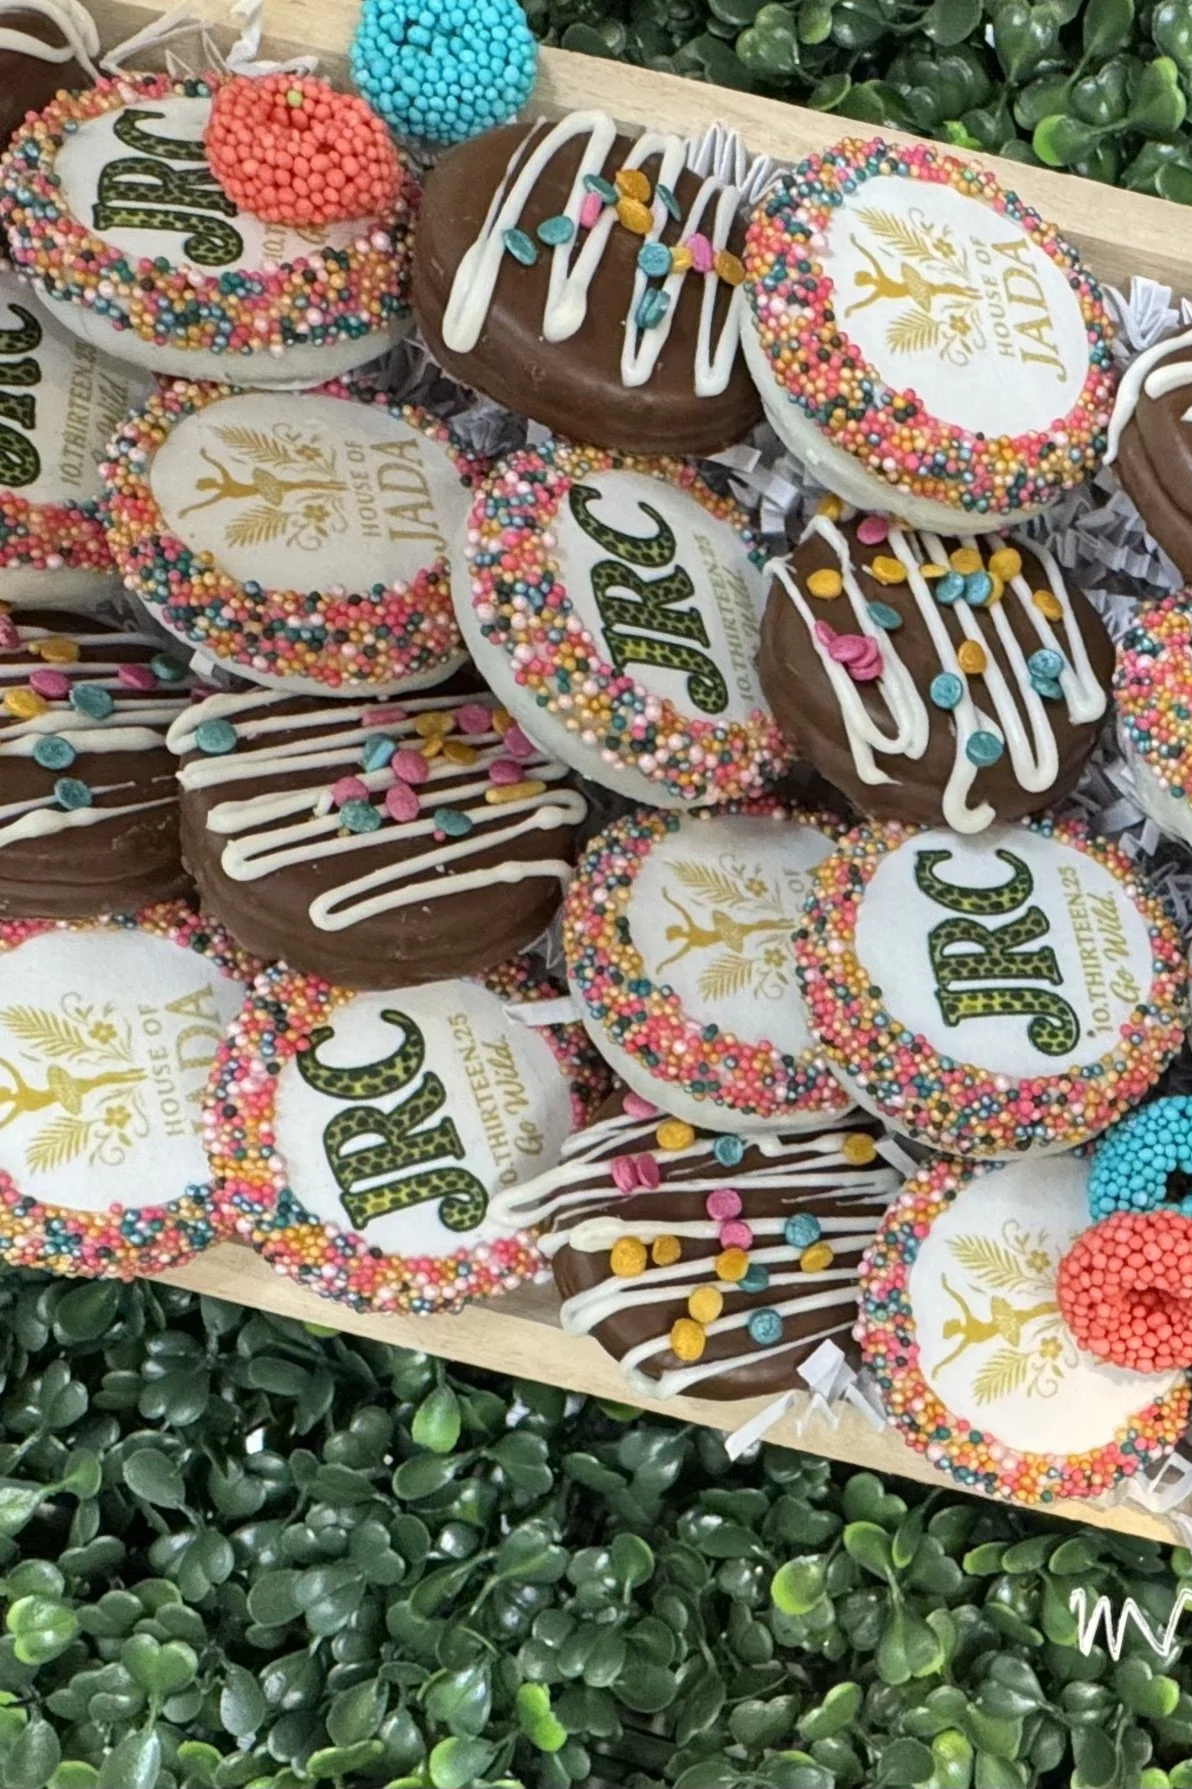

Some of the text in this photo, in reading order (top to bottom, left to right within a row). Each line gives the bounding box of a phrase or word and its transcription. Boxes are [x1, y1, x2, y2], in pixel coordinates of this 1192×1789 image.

[969, 234, 1015, 357] HOUSE OF
[991, 238, 1067, 383] JADA
[344, 440, 382, 537] HOUSE OF
[369, 438, 447, 552] JADA
[569, 484, 729, 714] JRC
[915, 849, 1081, 1056] JRC
[1057, 865, 1114, 1033] 10.THIRTEEN.25
[1086, 889, 1142, 1004] Go Wild.
[137, 1004, 185, 1137] HOUSE OF
[296, 1009, 490, 1231] JRC
[447, 1012, 519, 1188] 0.THIRTEEN.25
[481, 1033, 544, 1157] Go Wild.
